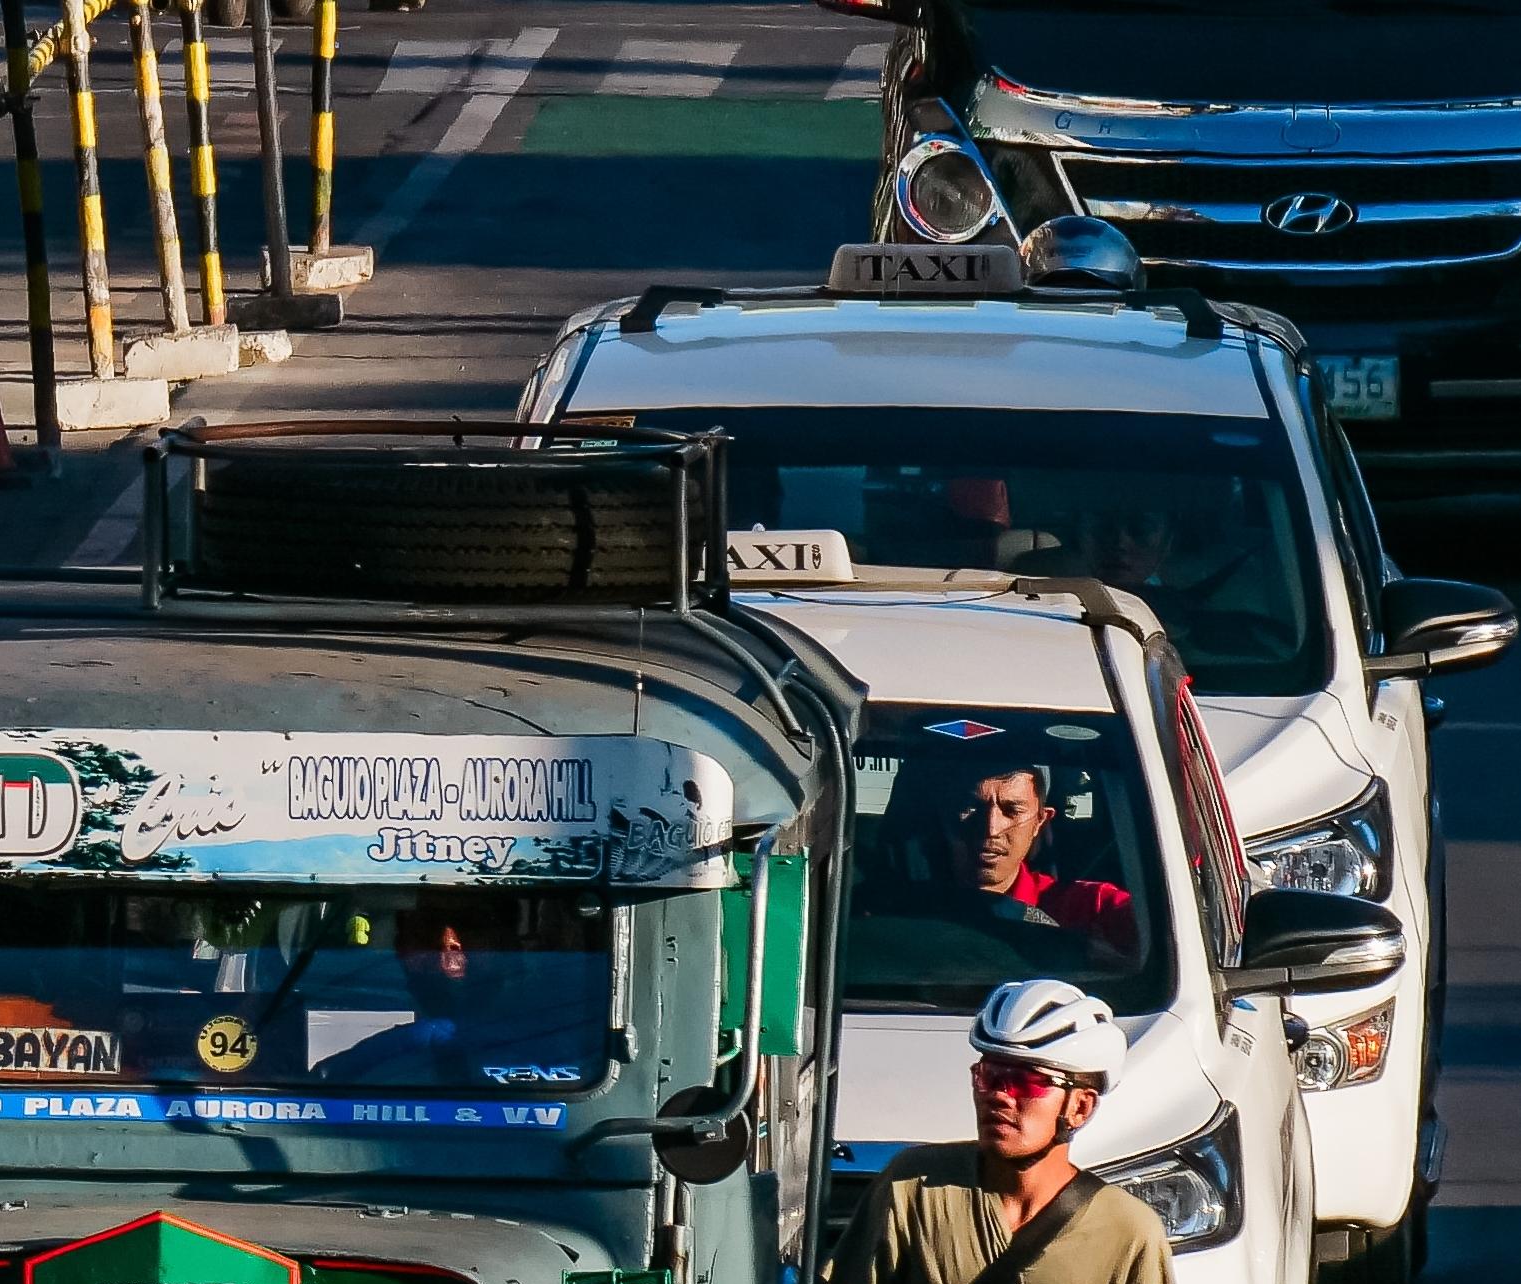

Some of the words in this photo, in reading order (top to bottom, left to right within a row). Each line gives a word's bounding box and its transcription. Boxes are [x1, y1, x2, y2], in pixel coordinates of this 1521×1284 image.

[858, 254, 981, 281] TAXI
[289, 756, 372, 820] BAGUIO
[373, 757, 443, 821] PLAZA
[459, 758, 551, 821] AURORA
[551, 759, 597, 822] HILL
[366, 827, 517, 868] Jitney
[209, 1031, 250, 1058] 94
[23, 1096, 143, 1117] PLAZA
[165, 1099, 327, 1120] AURORA
[353, 1104, 431, 1123] HILL
[454, 1107, 482, 1122] &
